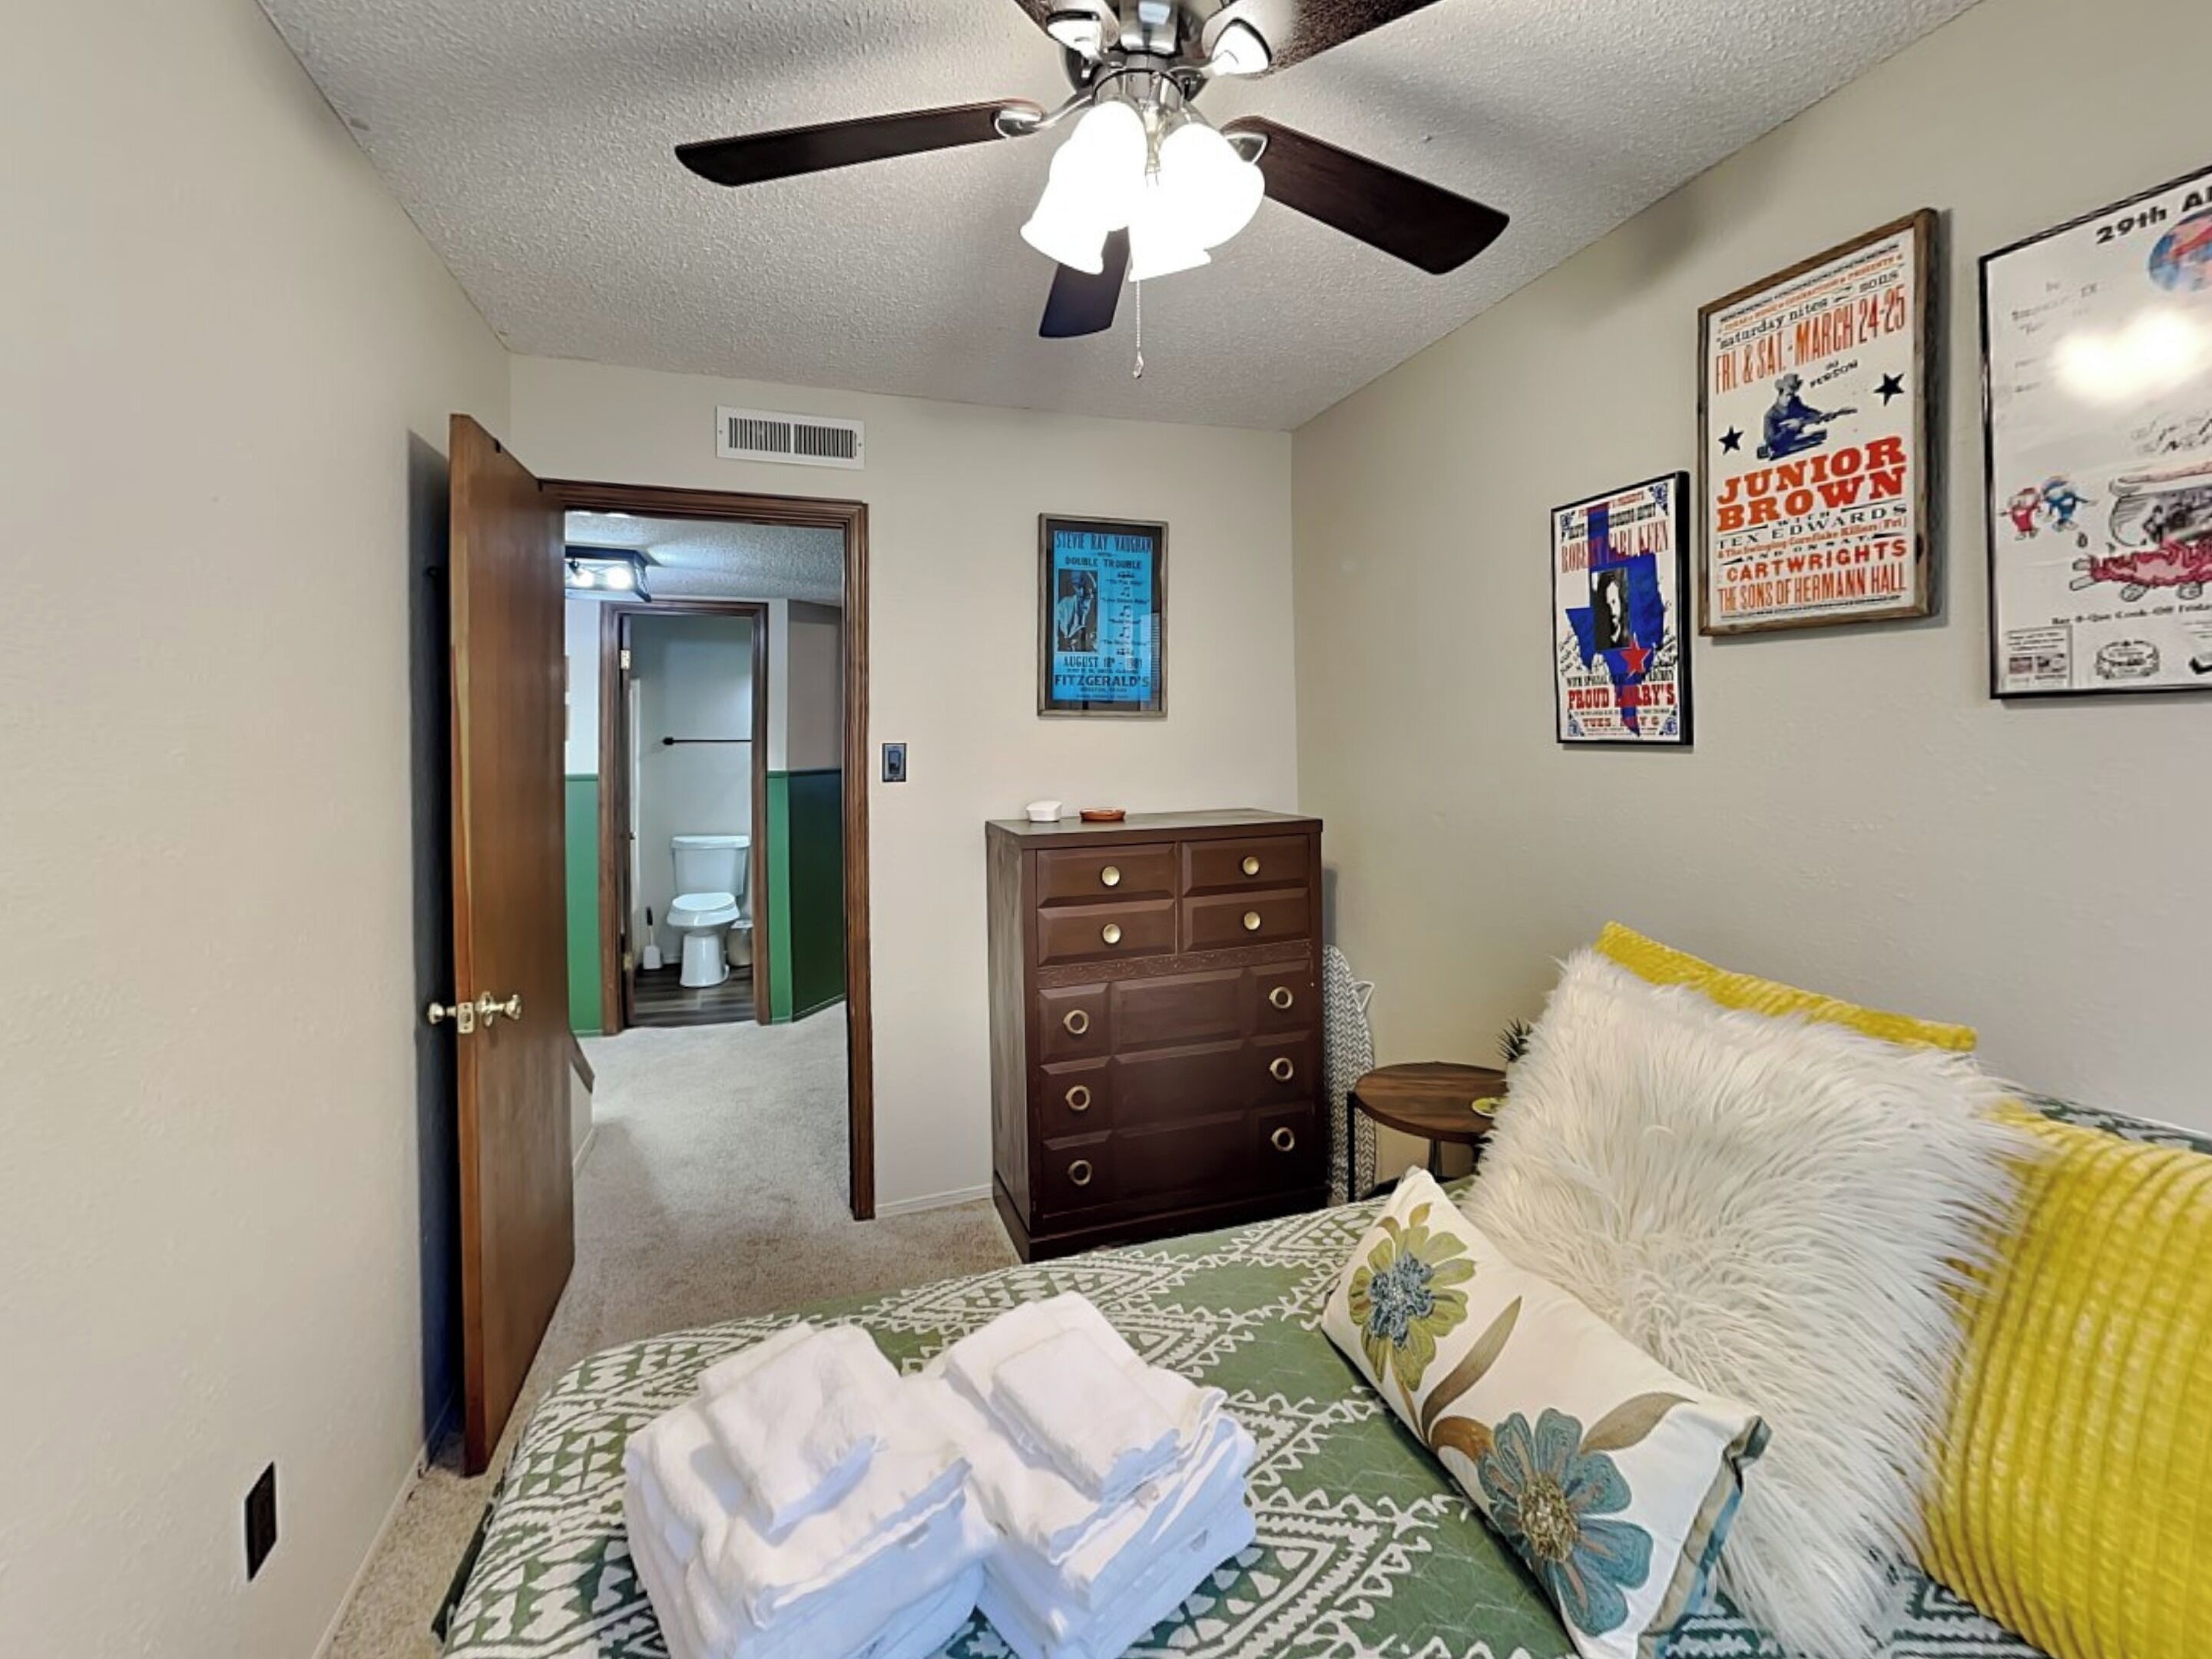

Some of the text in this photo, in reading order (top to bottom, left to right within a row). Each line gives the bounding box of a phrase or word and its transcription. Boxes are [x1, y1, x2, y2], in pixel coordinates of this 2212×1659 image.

[2096, 206, 2167, 244] 29th
[1743, 345, 1753, 384] &
[1795, 303, 1853, 366] MARCH
[1859, 283, 1905, 345] 24-25
[1717, 436, 1906, 505] JUNIOR
[1717, 466, 1906, 532] BROWN
[1056, 531, 1084, 549] STEVIE
[1717, 504, 1907, 551] TEX EDWARDS
[1065, 555, 1141, 570] DOUBLE TROUBLE
[1727, 539, 1907, 582] CARTWRIGHTS
[1717, 586, 1737, 612] THE
[1740, 581, 1773, 610] SONS
[1777, 579, 1792, 605] OF
[1794, 567, 1866, 603] HERMANN
[1871, 562, 1906, 594] HALL
[1055, 674, 1151, 687] FITZGERALD'S
[1064, 656, 1098, 668] AUGUST
[1568, 687, 1609, 710] PROUD
